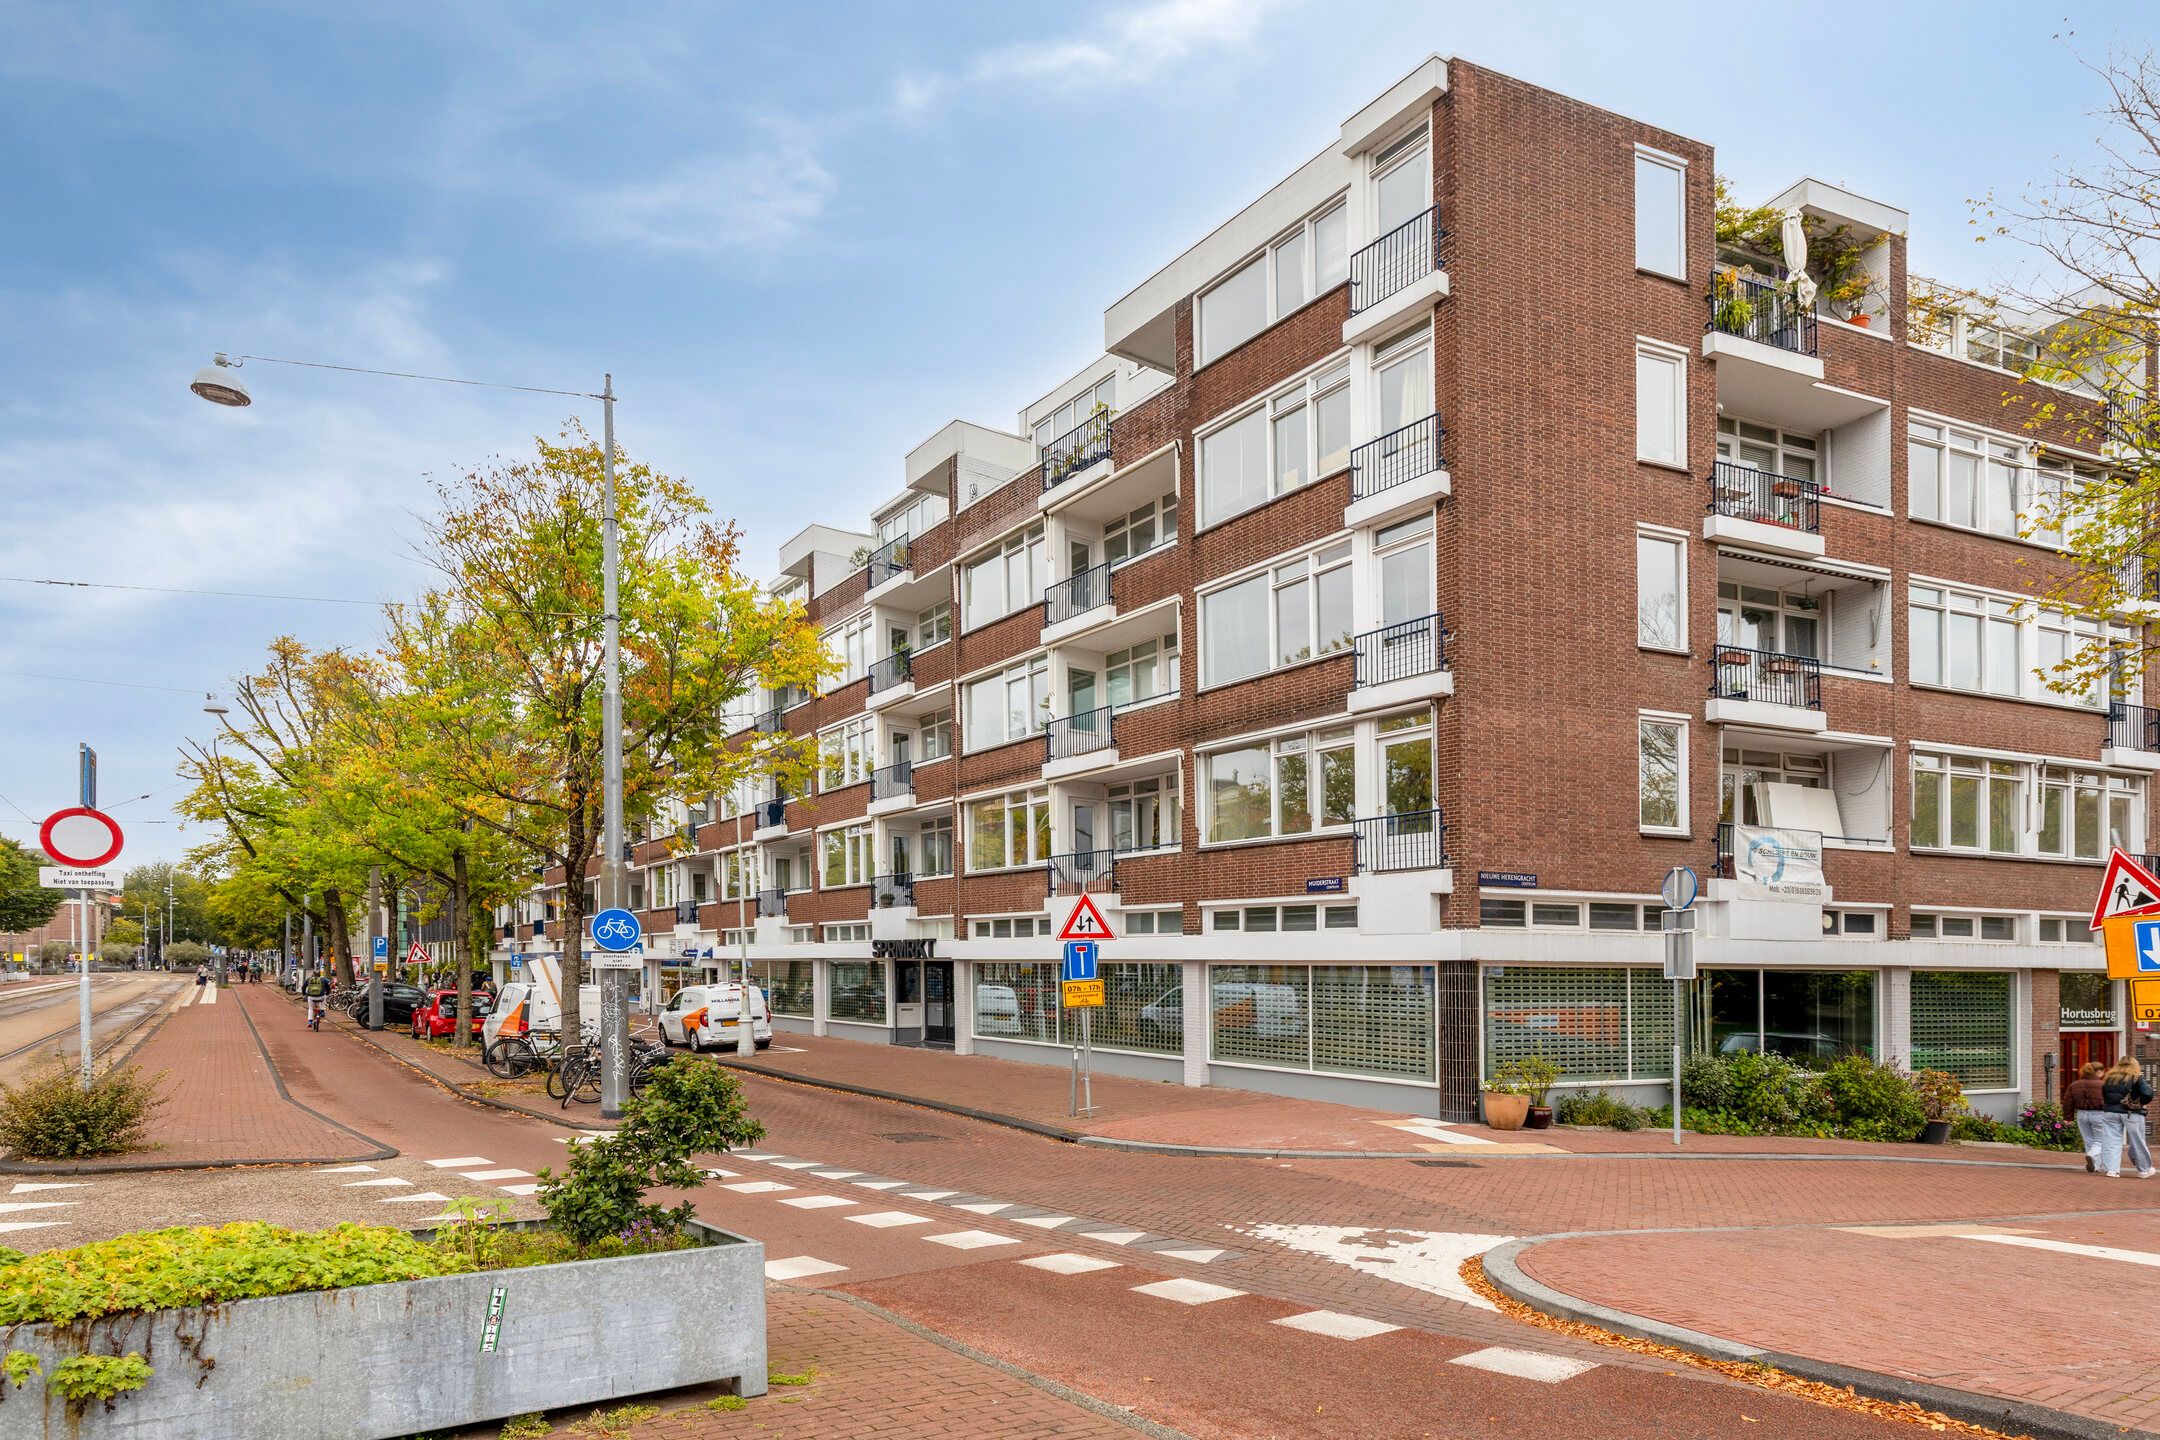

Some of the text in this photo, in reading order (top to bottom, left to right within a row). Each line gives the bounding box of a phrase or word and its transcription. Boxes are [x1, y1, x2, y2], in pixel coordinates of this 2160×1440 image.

[1800, 851, 1817, 859] BOUW
[74, 870, 106, 878] ontheffing
[1501, 873, 1536, 882] HERENGRACHT
[376, 938, 385, 949] P
[872, 939, 937, 959] SPRMRKT
[2061, 1007, 2116, 1022] Hortusbrug
